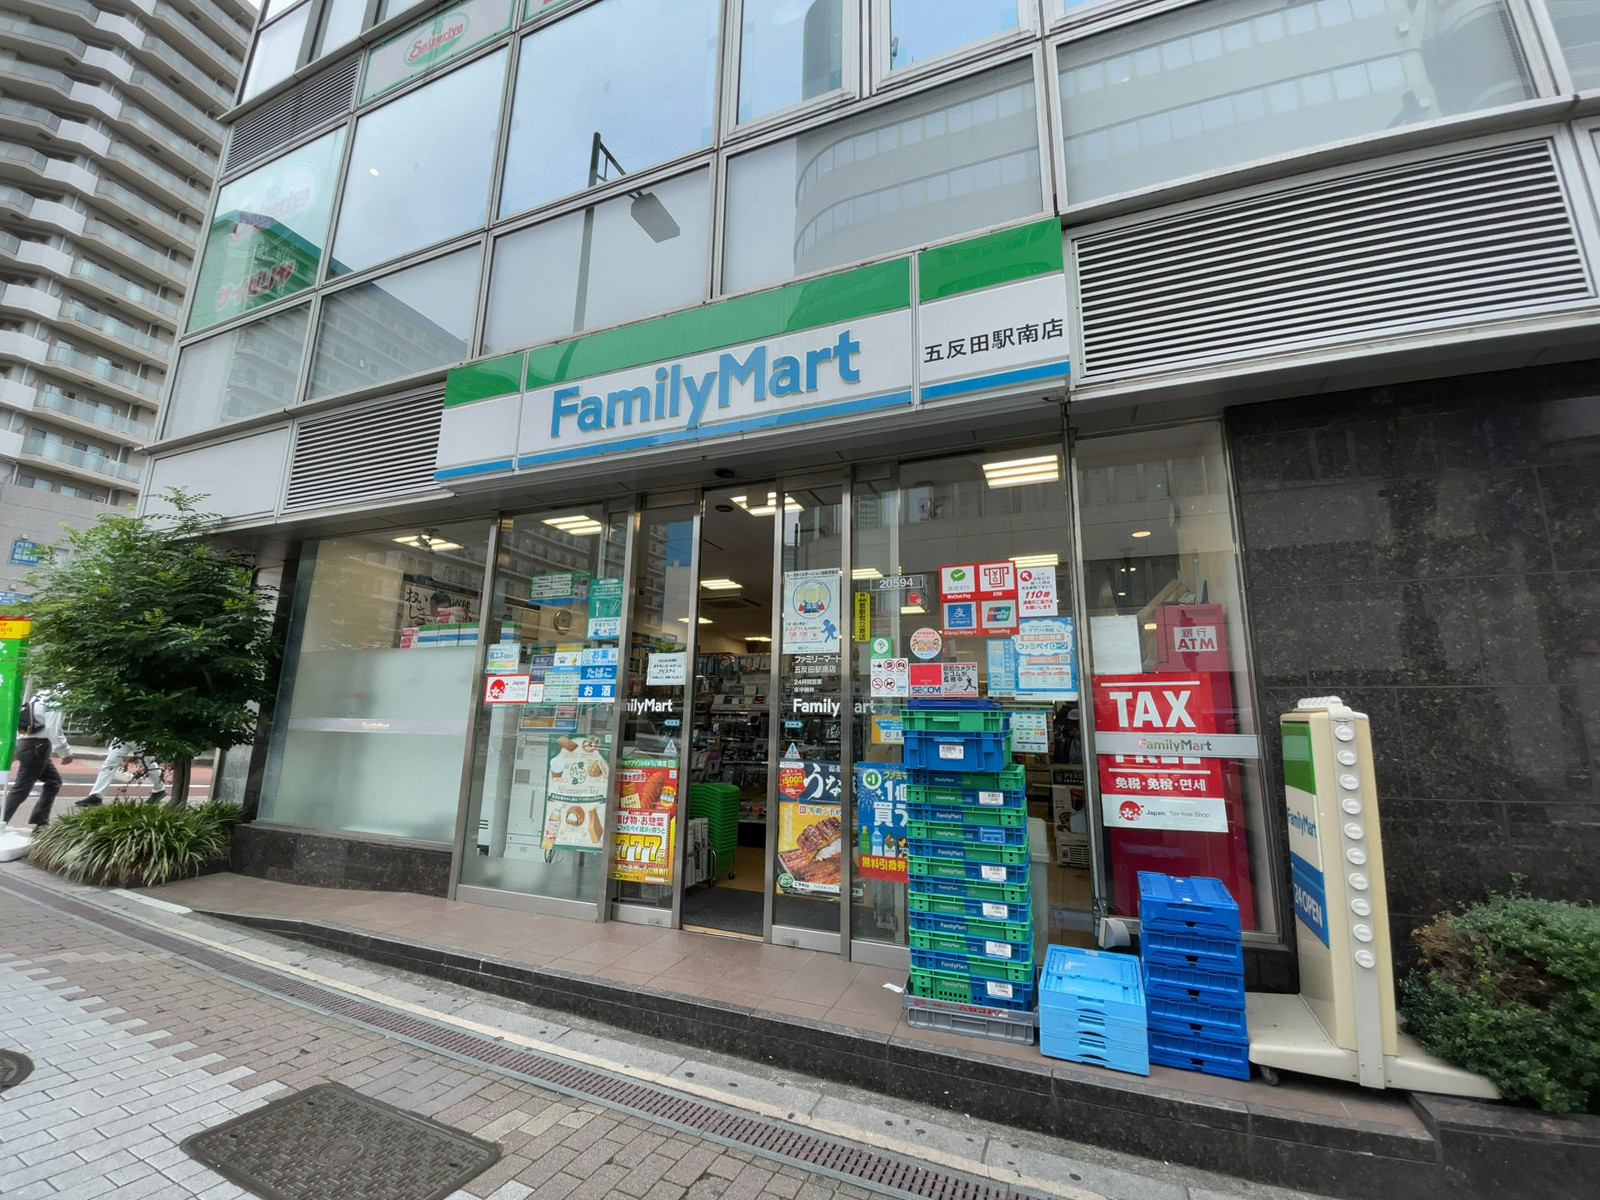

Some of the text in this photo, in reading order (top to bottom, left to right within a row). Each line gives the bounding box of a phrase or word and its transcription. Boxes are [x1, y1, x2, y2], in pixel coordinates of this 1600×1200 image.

[923, 318, 1063, 363] 五反田駅南店
[551, 329, 861, 438] FamilyMart
[878, 577, 914, 590] 20594
[1182, 628, 1207, 639] 銀行
[1177, 637, 1216, 651] ATM
[794, 655, 843, 664] ファミリーマート
[586, 666, 613, 679] たばこ
[911, 686, 942, 694] SECOM
[1108, 690, 1197, 728] TAX
[1138, 738, 1213, 752] FamilyMart
[936, 812, 962, 820] FamilyMart
[1287, 806, 1318, 839] FamilyMart
[937, 849, 964, 857] FamilyMart
[862, 856, 906, 872] 無料引換券
[938, 867, 966, 875] FamilyMart
[940, 922, 967, 931] FamilyMart
[941, 961, 968, 970] FamilyMart
[941, 980, 969, 989] FamilyMart
